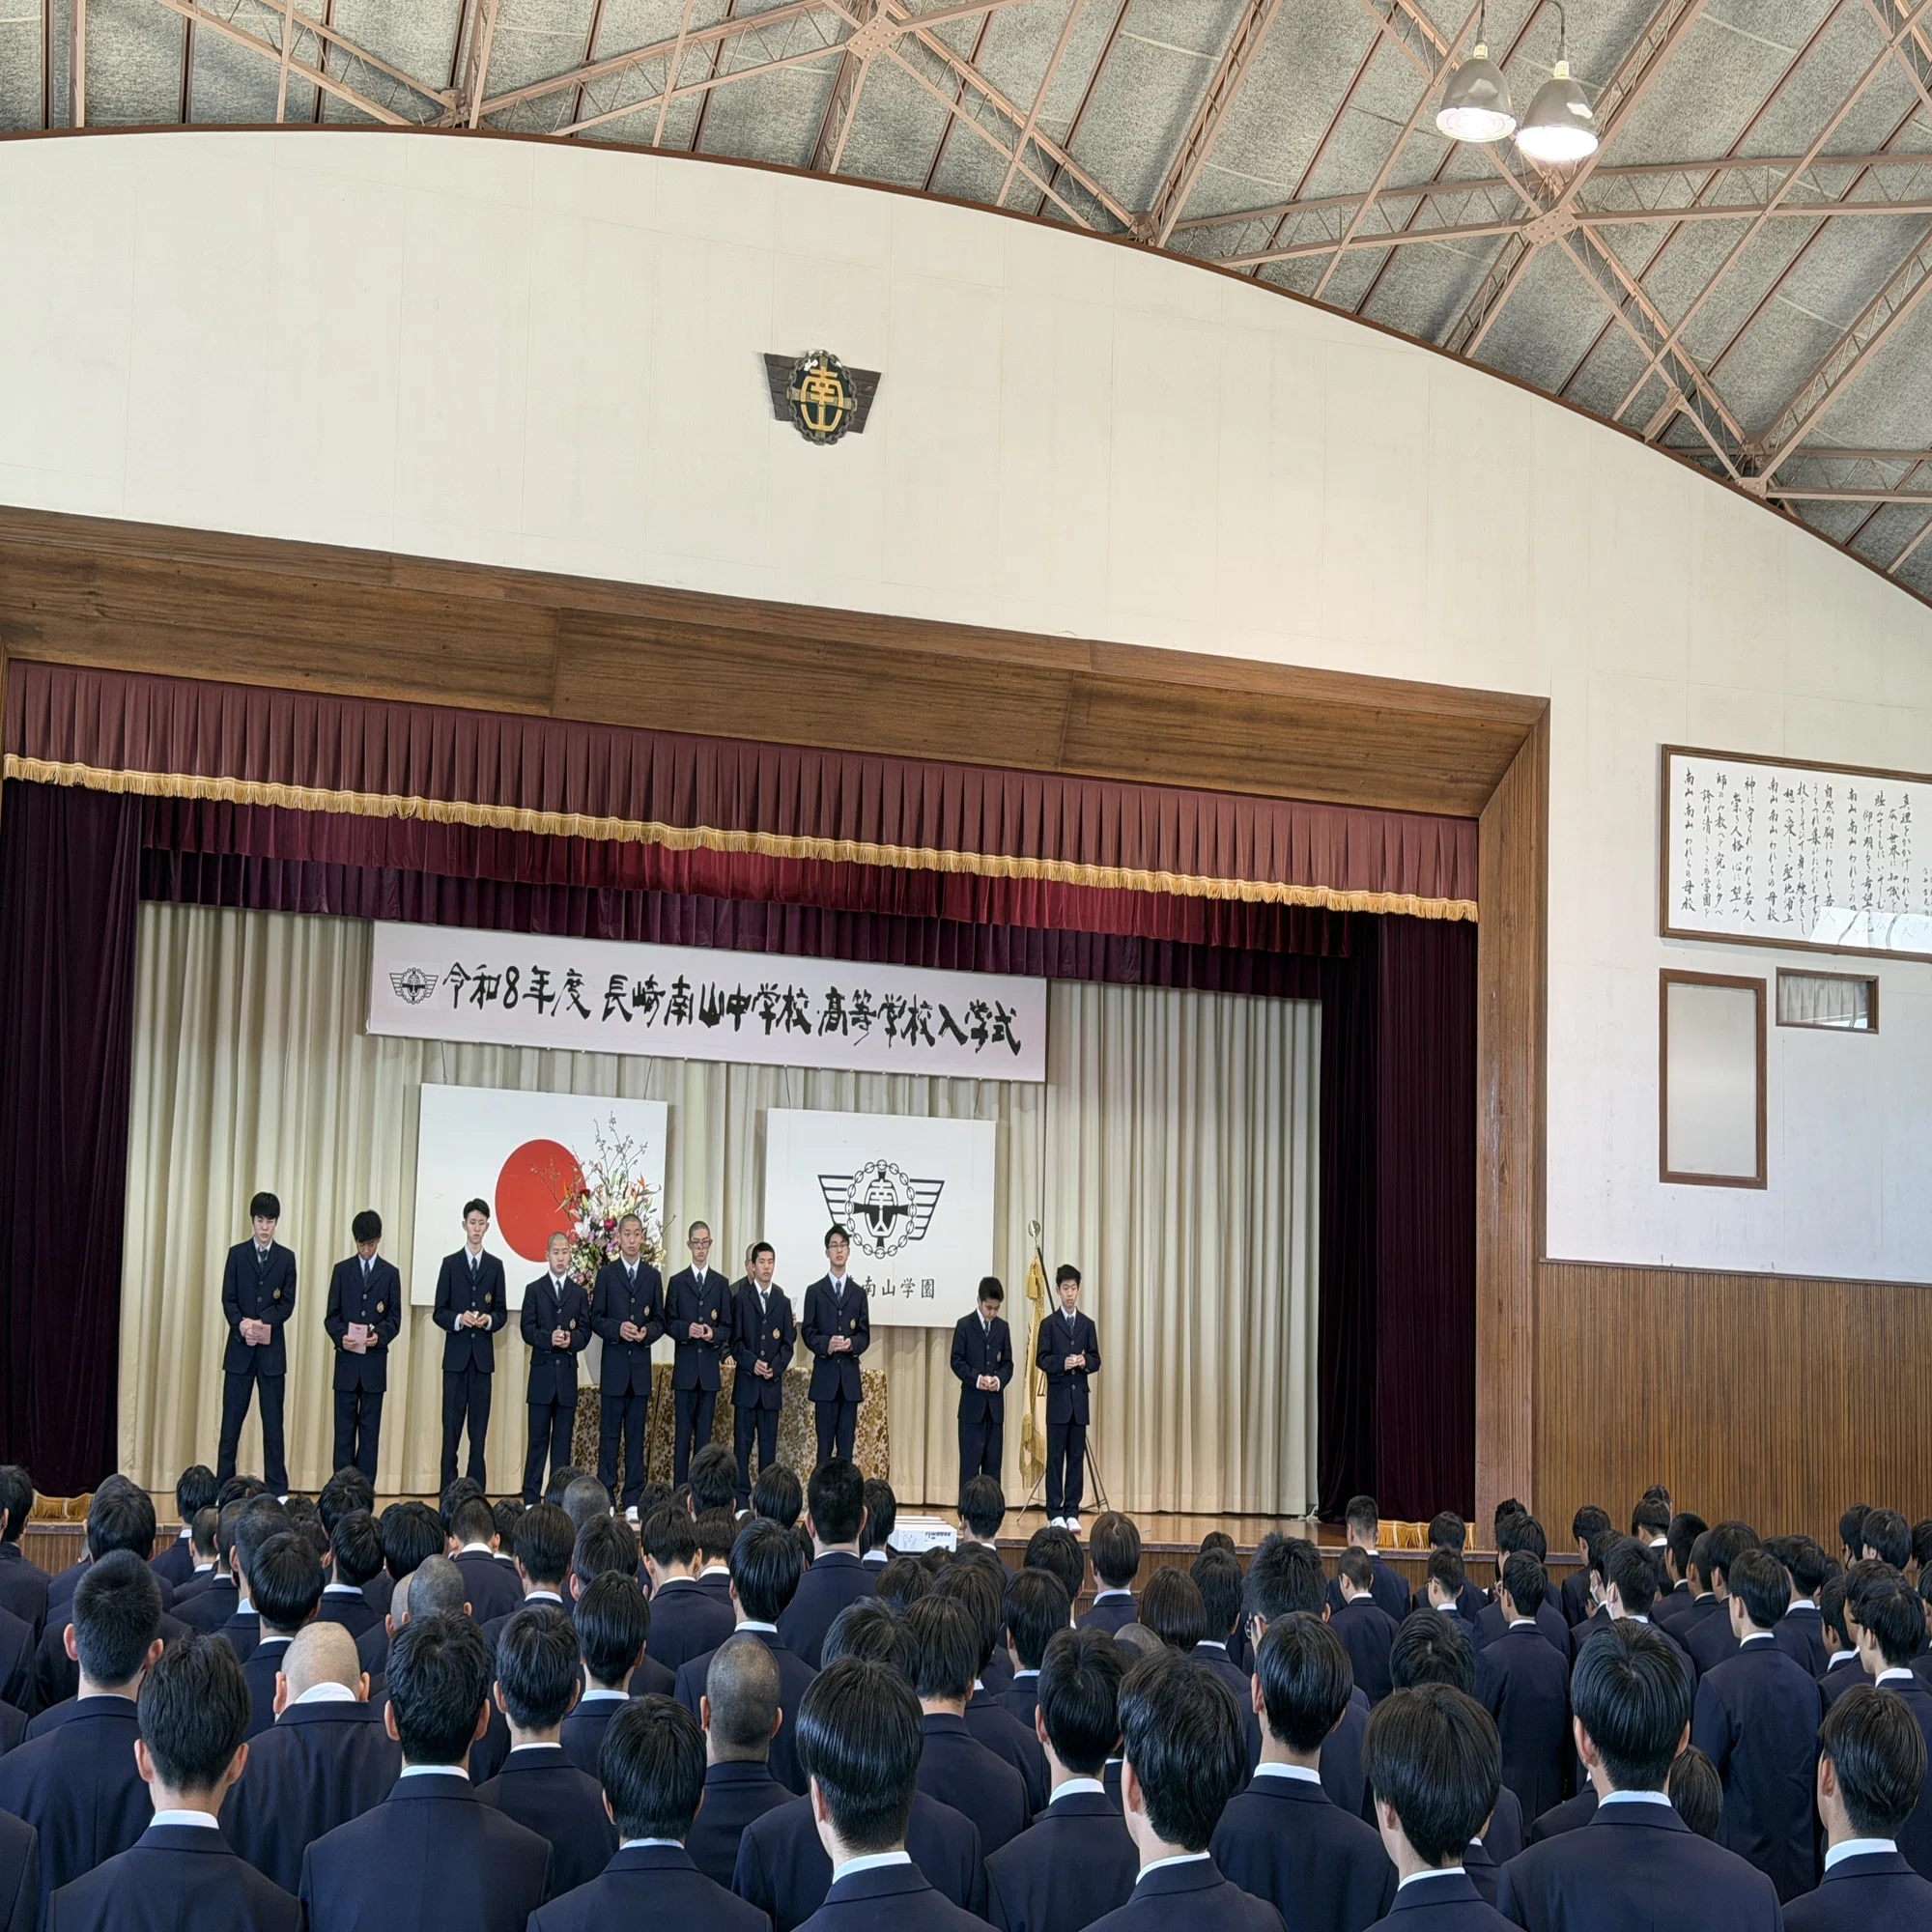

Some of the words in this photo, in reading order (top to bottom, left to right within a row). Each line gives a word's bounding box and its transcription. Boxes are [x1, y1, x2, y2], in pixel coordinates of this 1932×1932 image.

[441, 961, 592, 1020] 令和8年度
[848, 1274, 935, 1300] 南山学園
